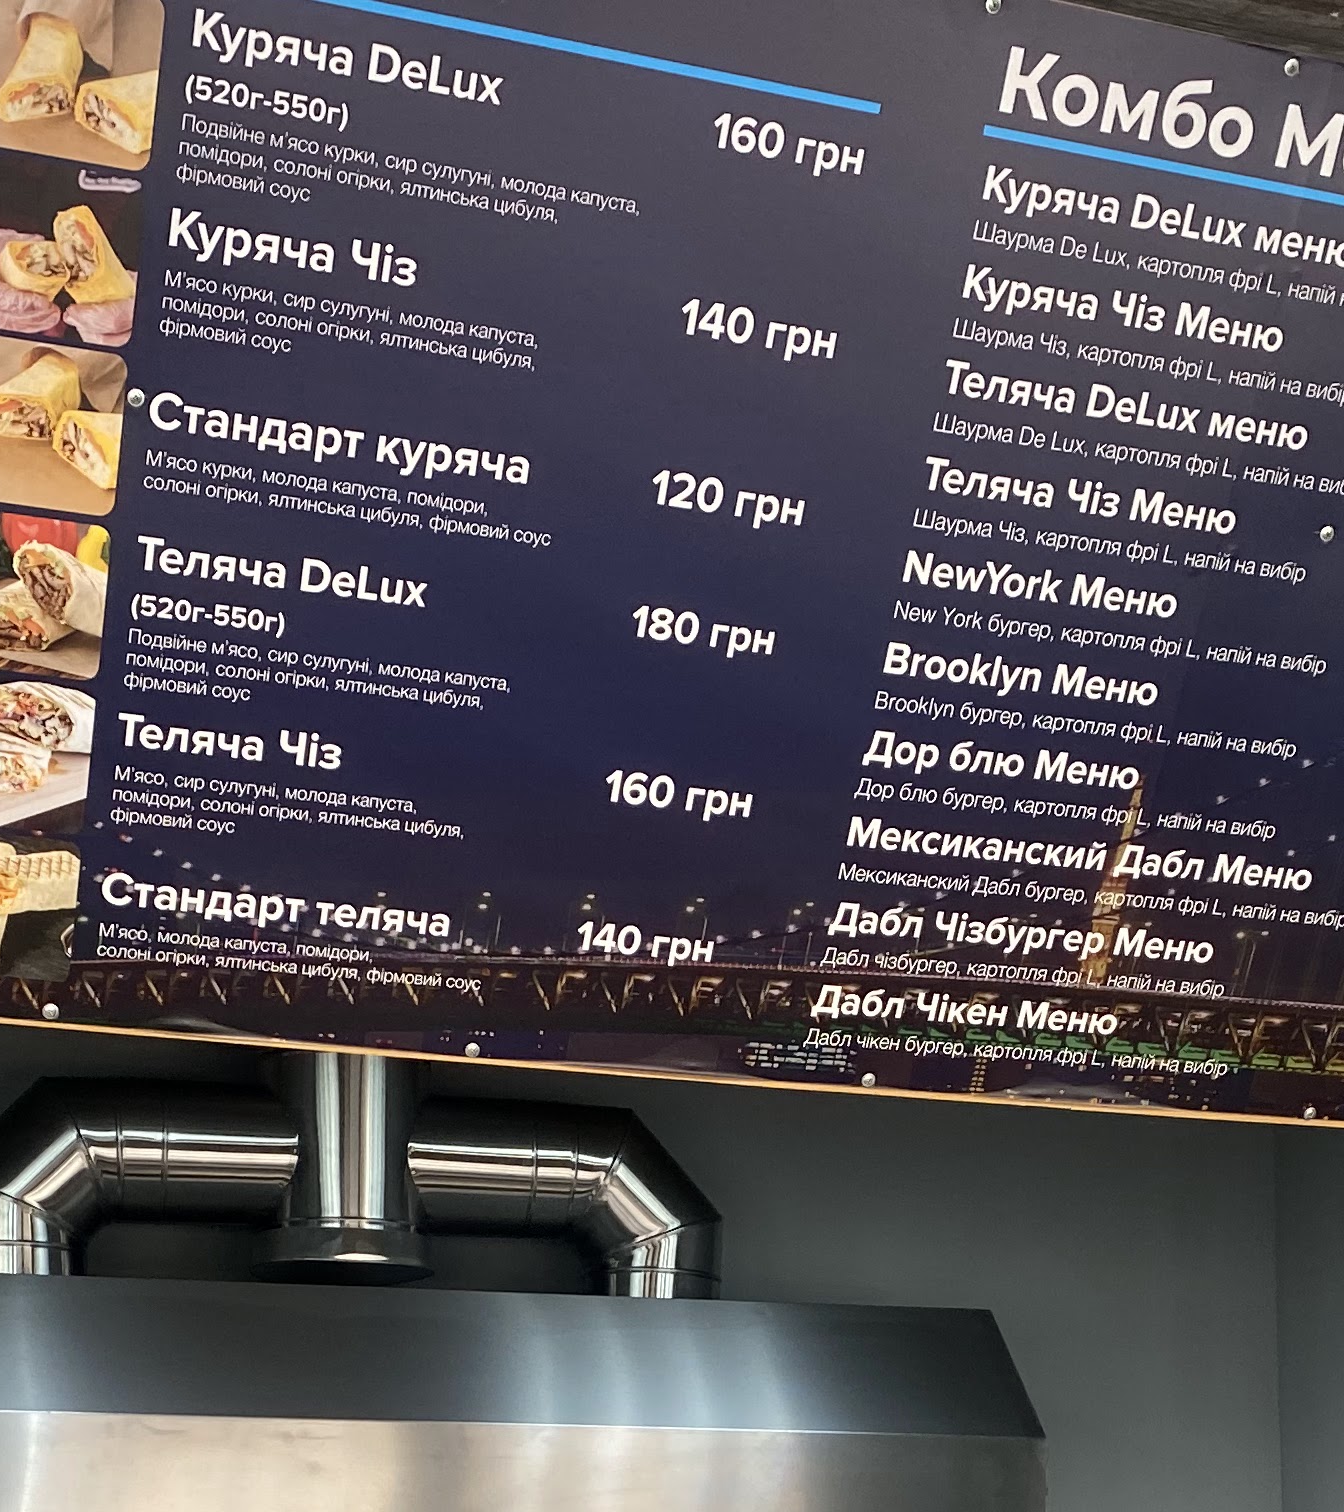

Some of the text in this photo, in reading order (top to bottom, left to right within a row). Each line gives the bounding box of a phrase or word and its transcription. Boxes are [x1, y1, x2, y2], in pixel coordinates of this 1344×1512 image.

[193, 9, 503, 105] Куряча DeLux
[186, 74, 348, 132] (520г-550г)
[999, 46, 1253, 157] Комбо
[182, 114, 639, 216] Подвійне м'ясо курки, сир сулугуні, молода капуста,
[715, 114, 864, 176] 160 грн
[983, 165, 1119, 224] Куряча
[1131, 194, 1246, 247] DeLux
[973, 220, 1054, 253] Шаурма
[1060, 236, 1087, 259] De
[1093, 242, 1129, 270] Lux,
[1137, 256, 1224, 284] картопля
[1229, 269, 1262, 293] фрі
[1266, 274, 1281, 297] L,
[1288, 283, 1335, 304] напій
[903, 550, 1177, 617] NewYork Меню
[894, 600, 1326, 676] New York бургер, картопля фрі L, напій на вибір
[883, 642, 1157, 705] Brooklyn Меню
[102, 873, 449, 936] Стандарт теляча
[97, 945, 481, 993] солоні огірки, ялтинська цибуля, фірмовий соус
[811, 985, 1117, 1034] Дабл Чікен Меню
[803, 1028, 1227, 1078] Дабл чікен бургер, картопля фрі L, напій на вибір
